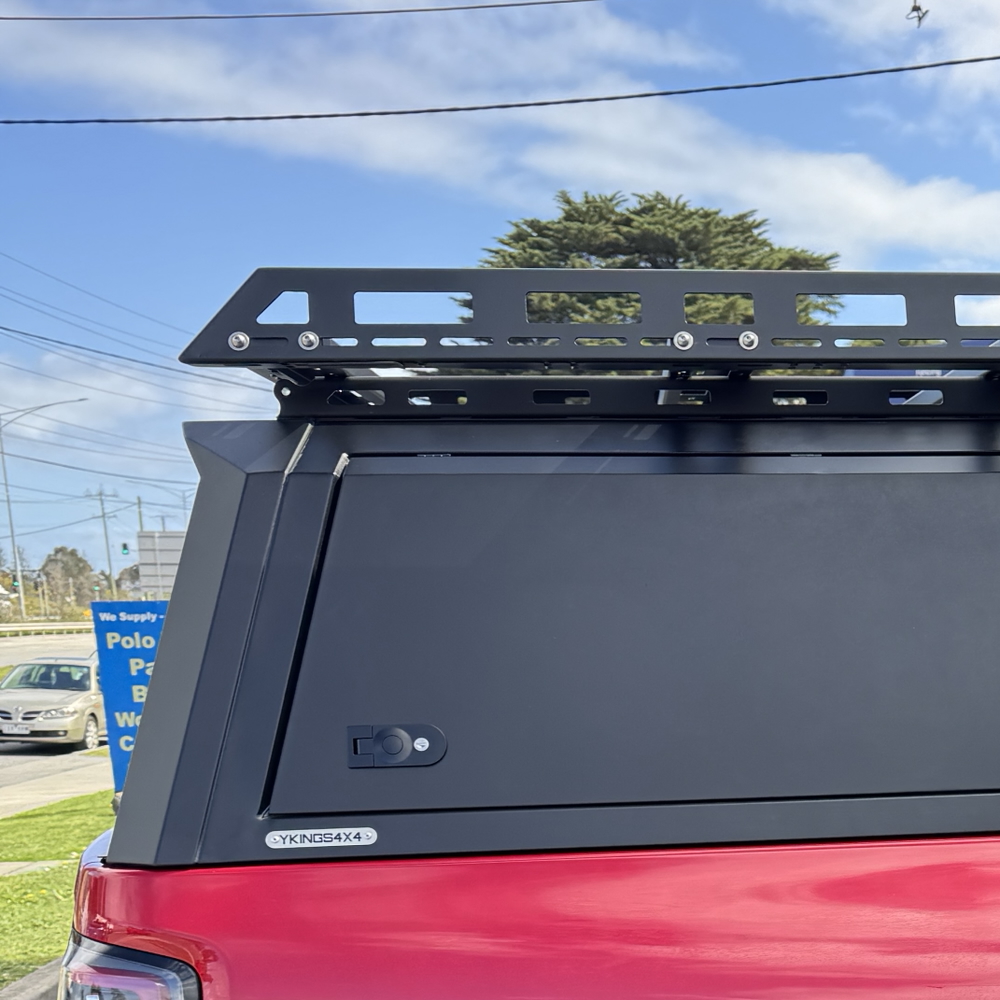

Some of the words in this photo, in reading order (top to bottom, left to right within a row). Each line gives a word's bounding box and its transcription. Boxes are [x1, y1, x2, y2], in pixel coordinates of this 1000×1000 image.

[98, 612, 117, 622] We
[119, 611, 157, 623] Supply
[105, 631, 155, 649] Polo
[279, 831, 363, 845] YKINGS4X4
